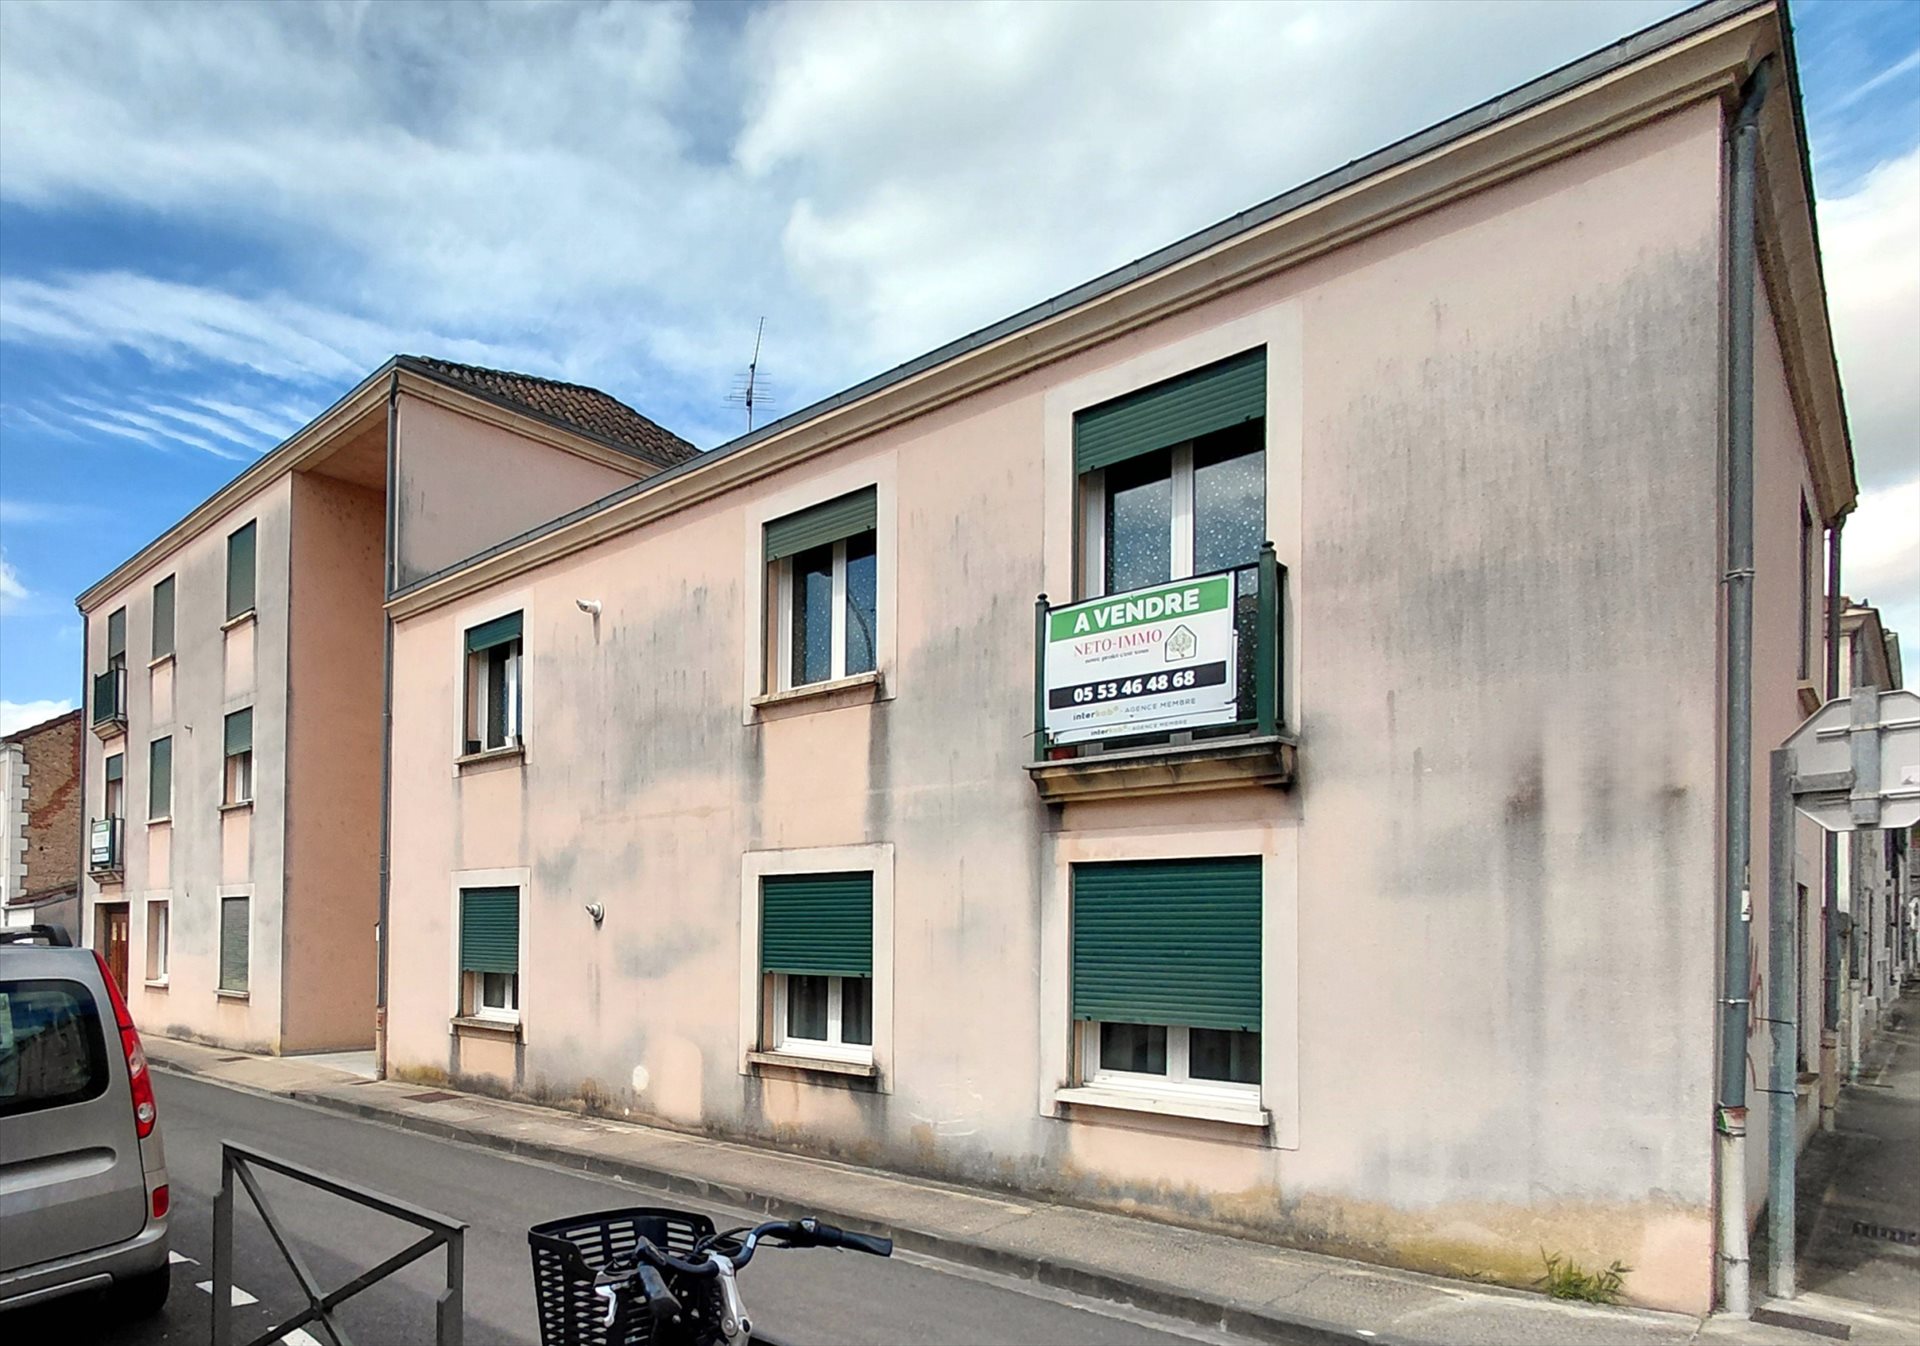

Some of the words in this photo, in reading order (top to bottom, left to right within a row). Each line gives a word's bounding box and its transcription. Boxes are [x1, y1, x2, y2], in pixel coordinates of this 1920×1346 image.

[1073, 612, 1090, 634] A
[1094, 588, 1200, 629] VENDRE
[1074, 629, 1163, 657] NETO-IMMO
[1073, 687, 1093, 703] 05
[1097, 683, 1117, 699] 53
[1121, 678, 1142, 695] 46
[1146, 674, 1169, 691] 48
[1172, 670, 1195, 687] 68
[1124, 703, 1158, 713] AGENCE
[1159, 698, 1196, 709] MEMBRE
